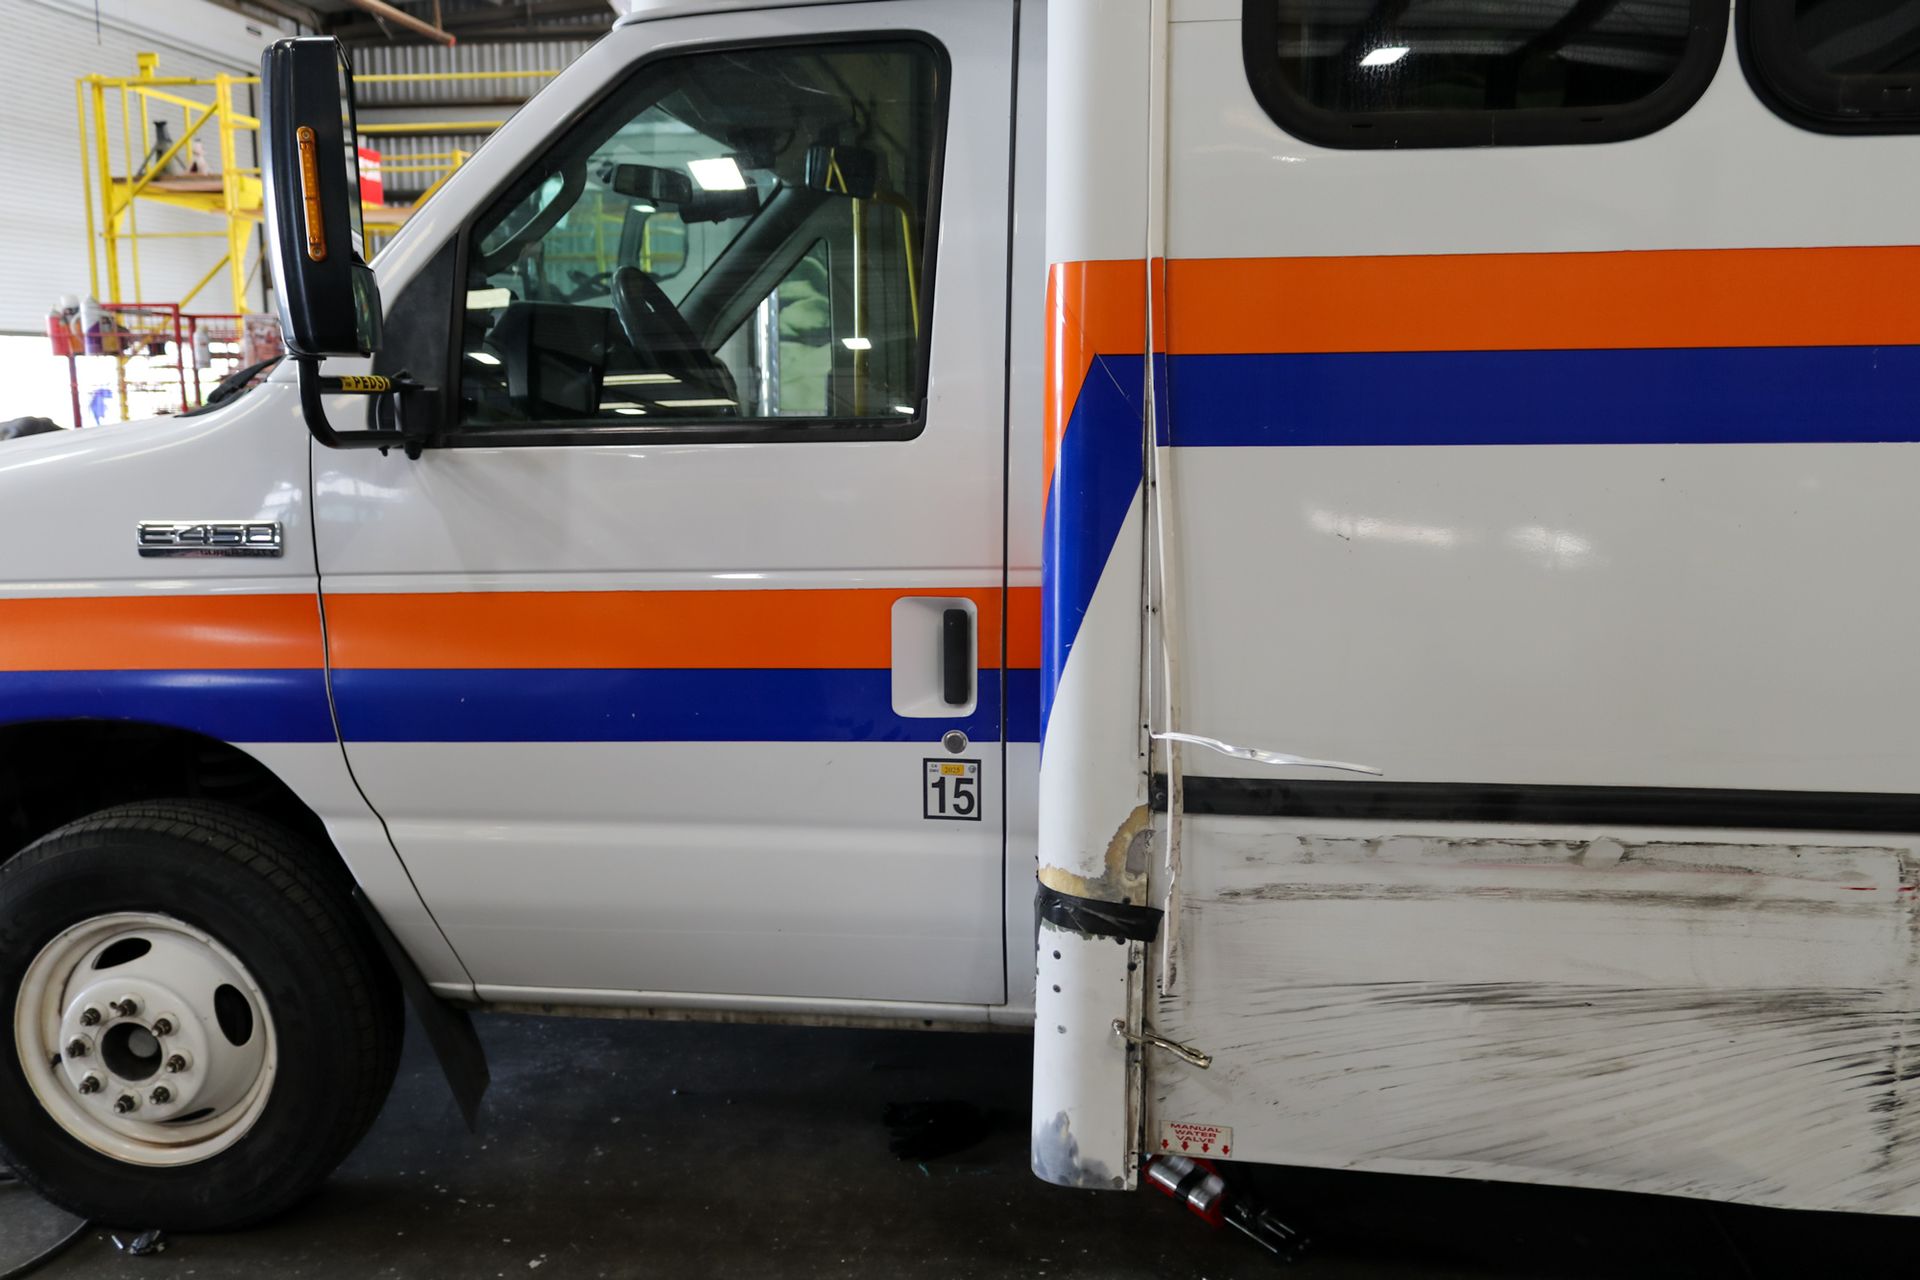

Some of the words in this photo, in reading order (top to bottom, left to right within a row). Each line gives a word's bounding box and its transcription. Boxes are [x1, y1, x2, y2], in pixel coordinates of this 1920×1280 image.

[931, 776, 975, 815] 15
[1170, 1123, 1222, 1133] MANUAL
[1174, 1129, 1217, 1138] WATER
[1175, 1135, 1215, 1144] VALVE
